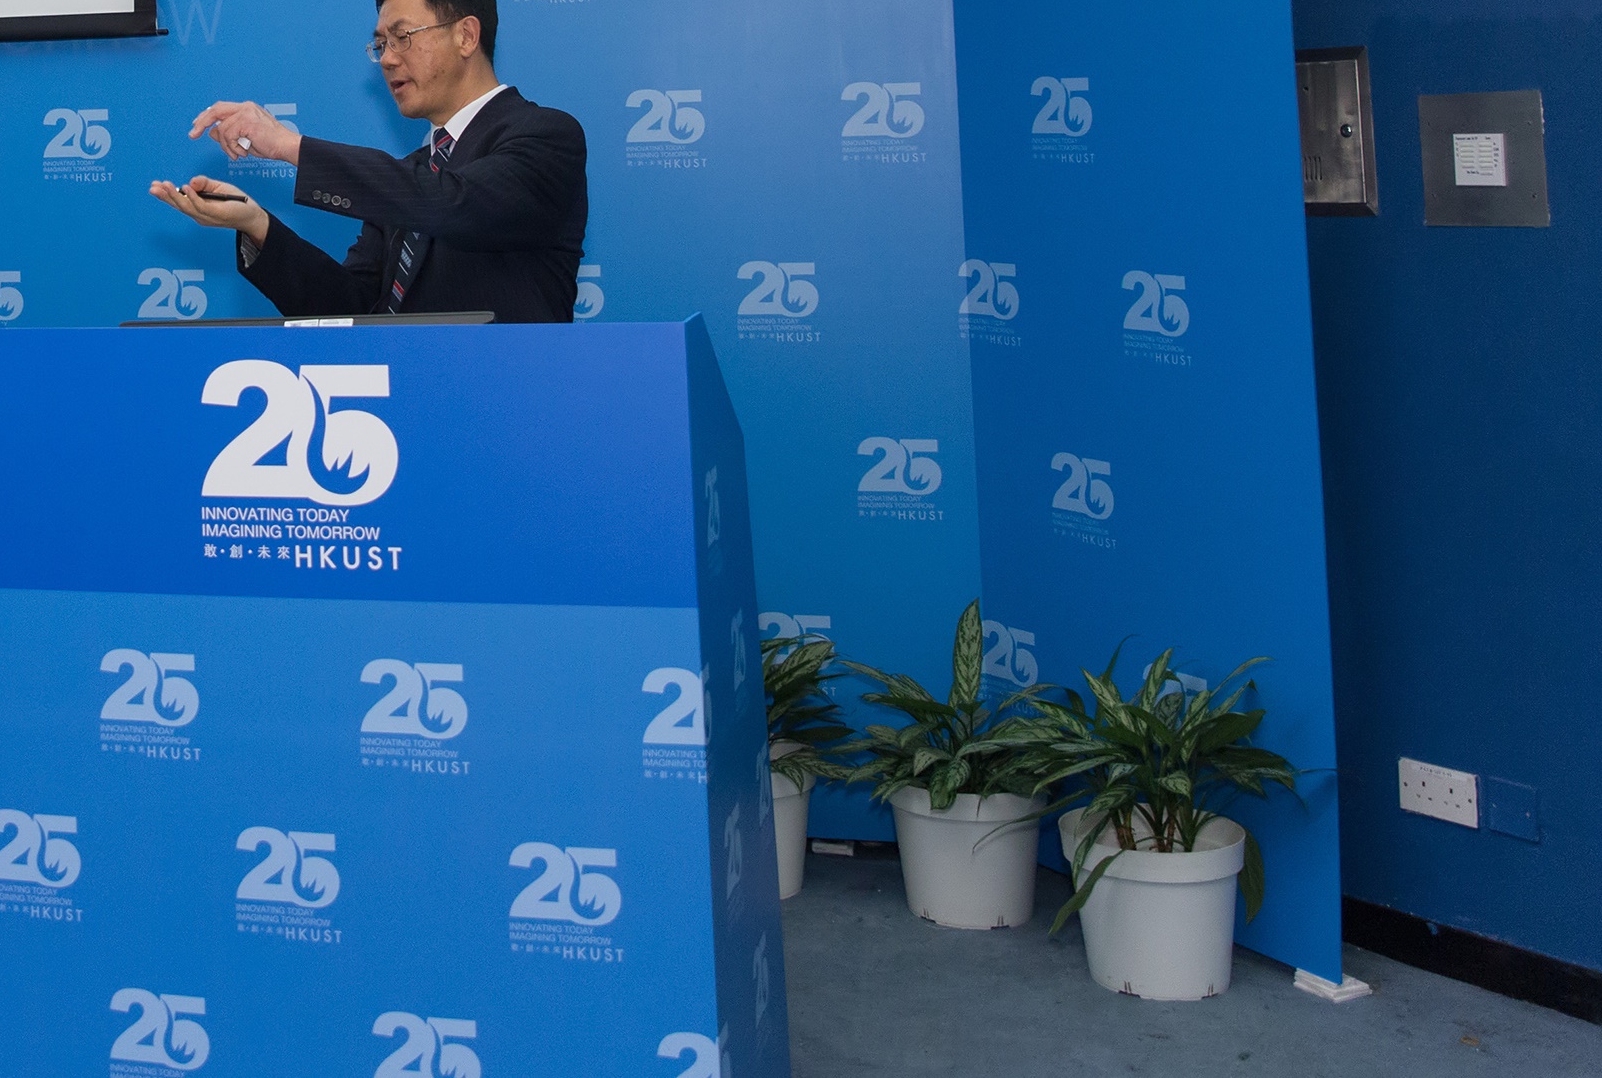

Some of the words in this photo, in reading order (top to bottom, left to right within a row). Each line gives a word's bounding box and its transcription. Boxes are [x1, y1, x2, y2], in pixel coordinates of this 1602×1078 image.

[201, 359, 398, 506] 25
[857, 437, 942, 496] 25
[201, 507, 293, 521] INNOVATING
[297, 508, 349, 522] TODAY
[898, 510, 944, 521] HKUST
[202, 524, 282, 538] IMAGINING
[285, 526, 380, 540] TOMORROW
[295, 545, 402, 570] HKUST
[100, 648, 199, 727] 25
[360, 658, 468, 739] 25
[100, 724, 147, 733] INNOVATING
[149, 725, 174, 735] TODAY
[100, 733, 140, 742] IMAGINING
[143, 735, 190, 745] TOMORROW
[147, 745, 201, 761] HKUST
[412, 760, 470, 774] HKUST
[236, 826, 340, 908] 25
[509, 842, 621, 926] 25
[30, 905, 82, 922] HKUST
[286, 926, 342, 943] HKUST
[562, 946, 624, 962] HKUST
[109, 988, 210, 1070] 25
